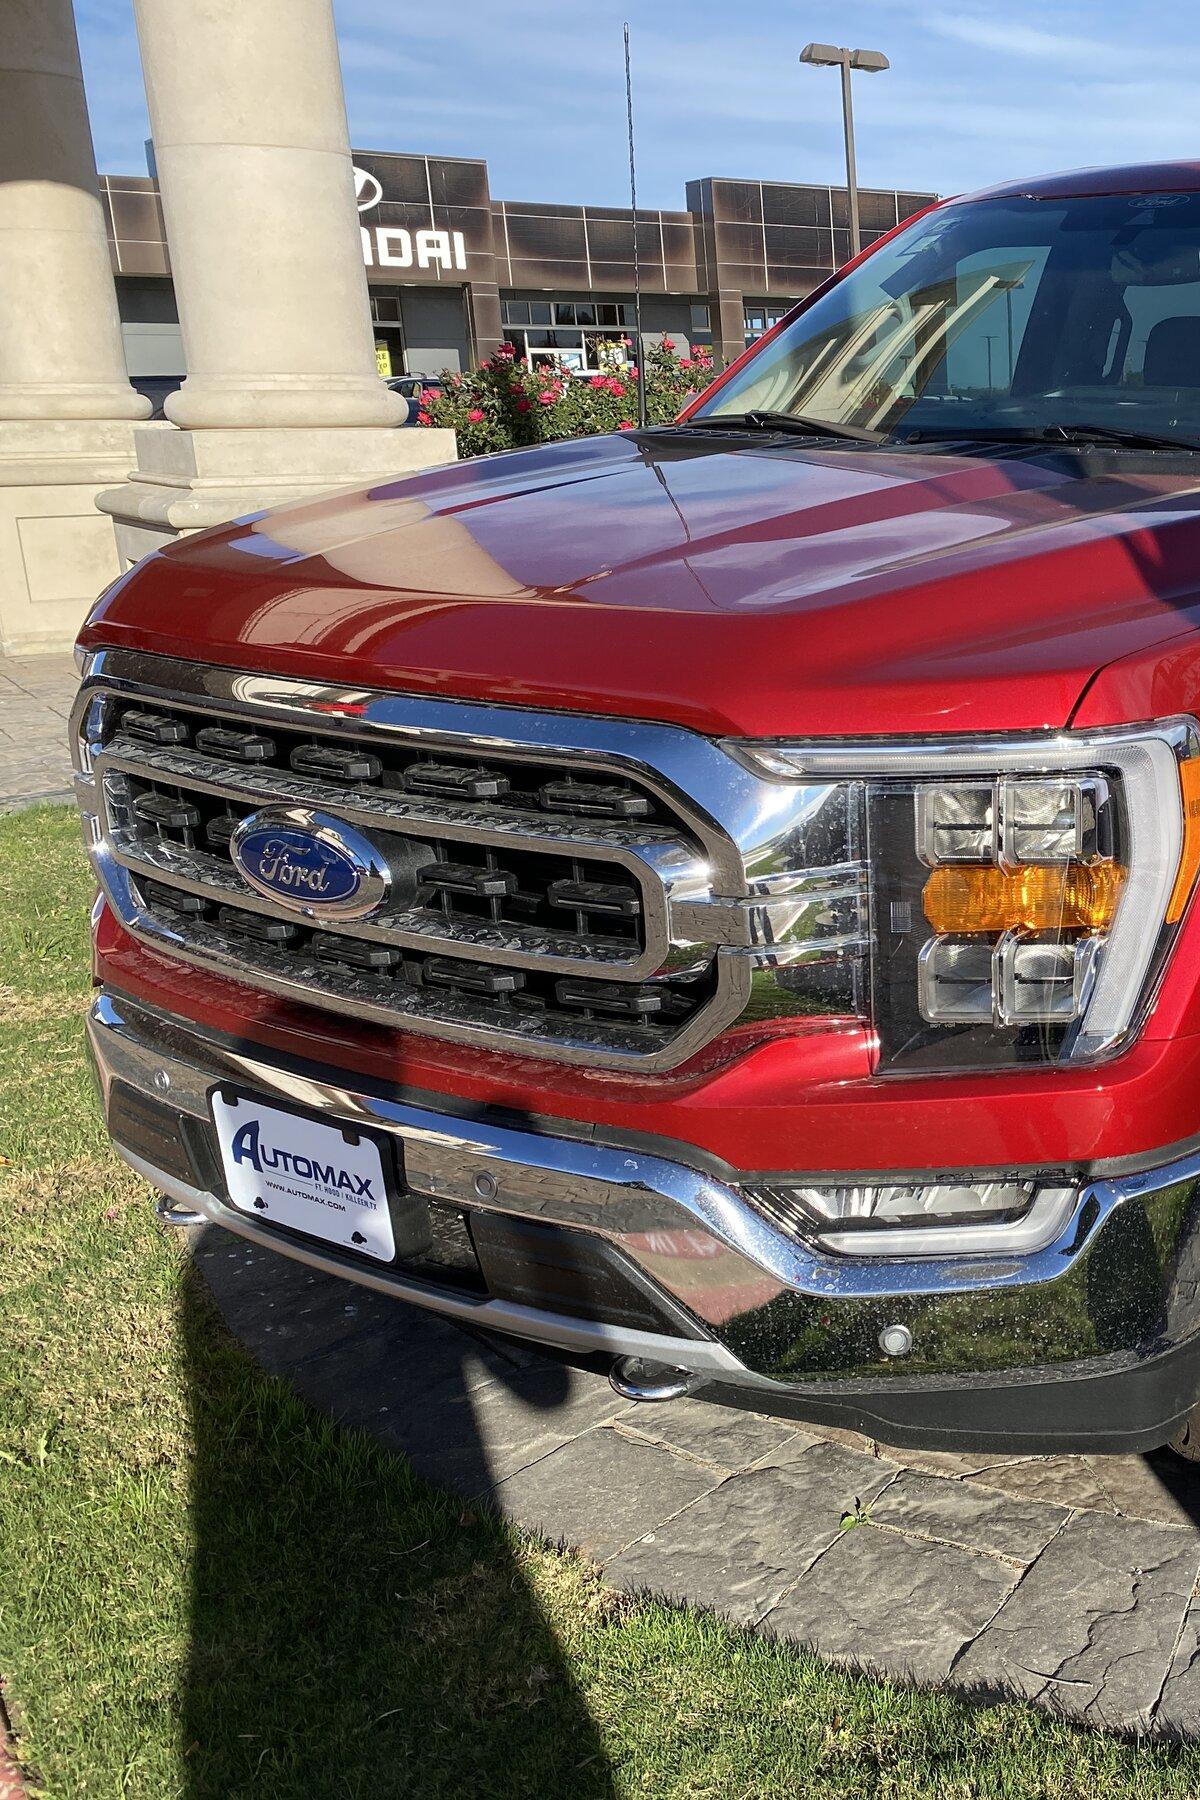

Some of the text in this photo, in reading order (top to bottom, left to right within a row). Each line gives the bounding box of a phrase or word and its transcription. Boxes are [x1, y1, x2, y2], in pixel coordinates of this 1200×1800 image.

[258, 838, 331, 892] Ford
[264, 1179, 346, 1213] WWW.AUTOMAX.COM
[324, 1187, 340, 1197] HOOD
